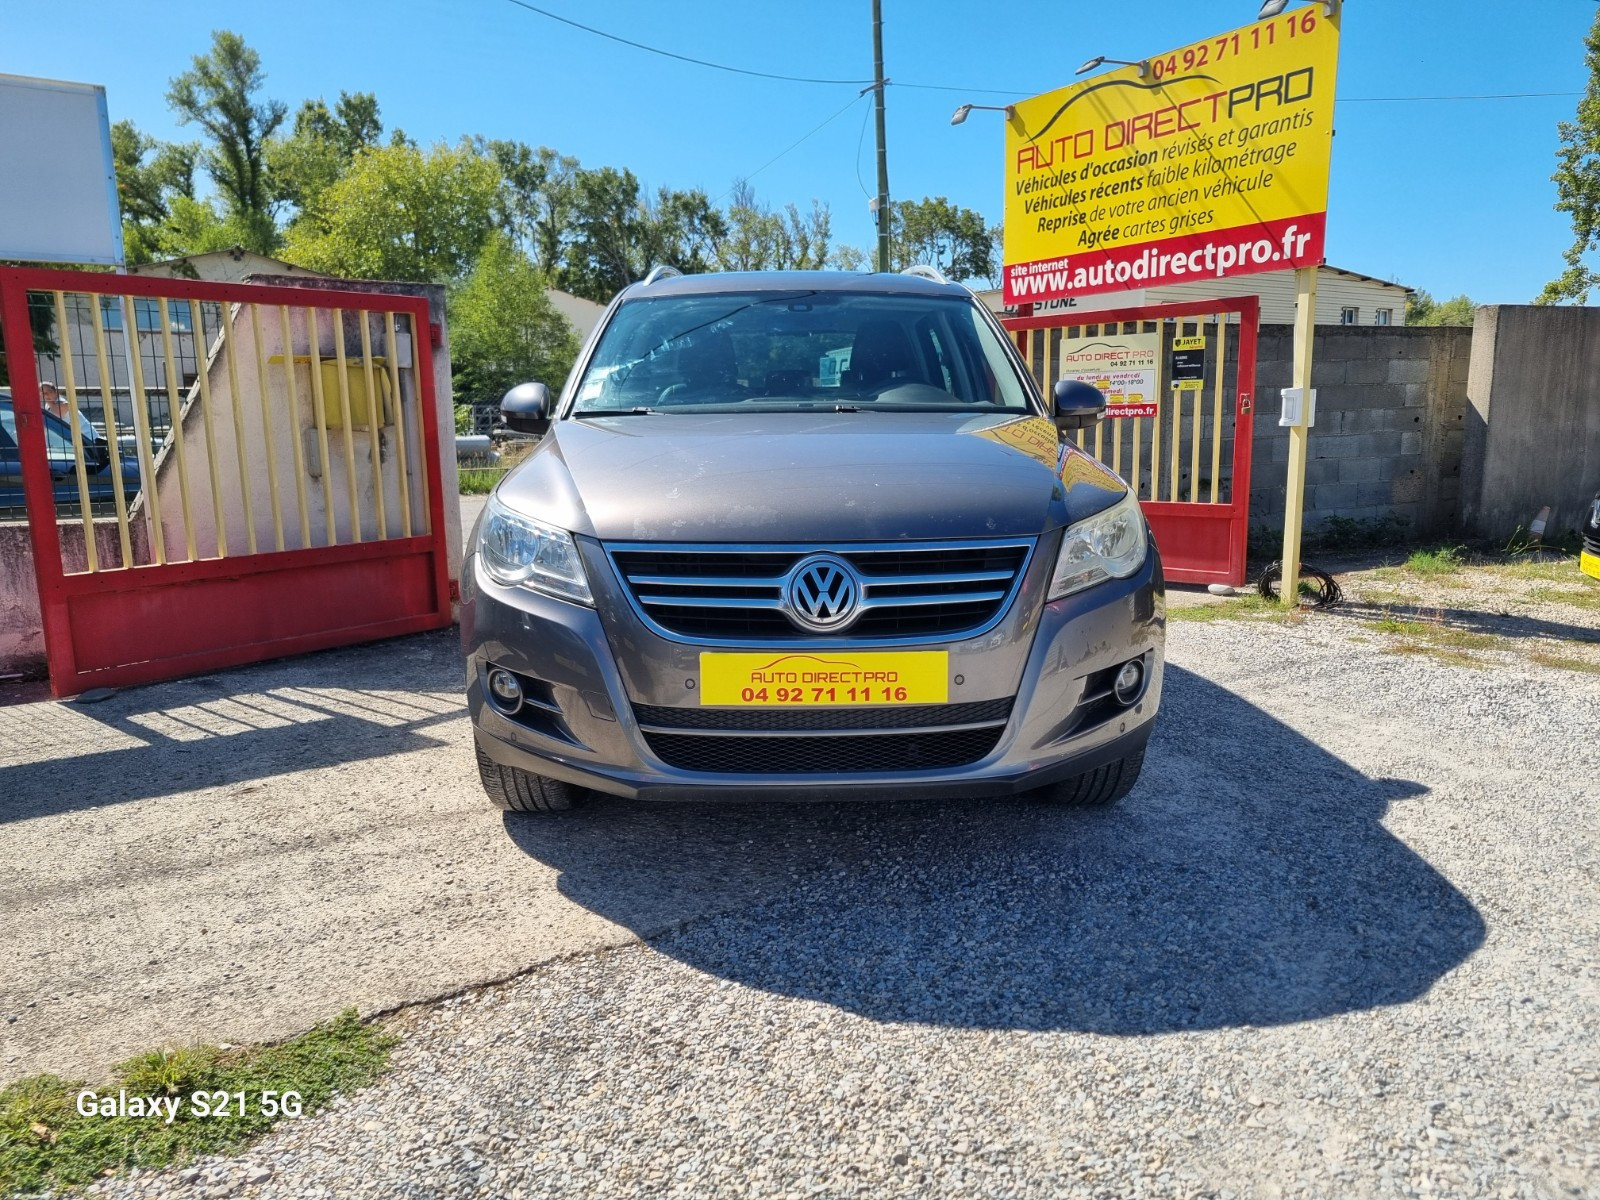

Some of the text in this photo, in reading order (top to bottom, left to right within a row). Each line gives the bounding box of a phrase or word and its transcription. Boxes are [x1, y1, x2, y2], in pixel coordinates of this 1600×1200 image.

[1152, 9, 1316, 80] 04 92 71 11 16
[1016, 108, 1314, 196] Véhicules d'occasion révisés et garantis
[1017, 129, 1094, 174] AUTO
[1025, 141, 1297, 215] Véhicules récents faible kilométrage
[1037, 170, 1273, 234] Reprise de votre ancien véhicule
[1077, 209, 1214, 249] Agrée cartes grises
[1010, 225, 1311, 297] www.autodirectpro.fr
[1010, 258, 1069, 277] site internet
[1066, 353, 1092, 362] AUTO
[741, 686, 908, 702] 04 92 71 11 16
[751, 672, 797, 683] AUTO
